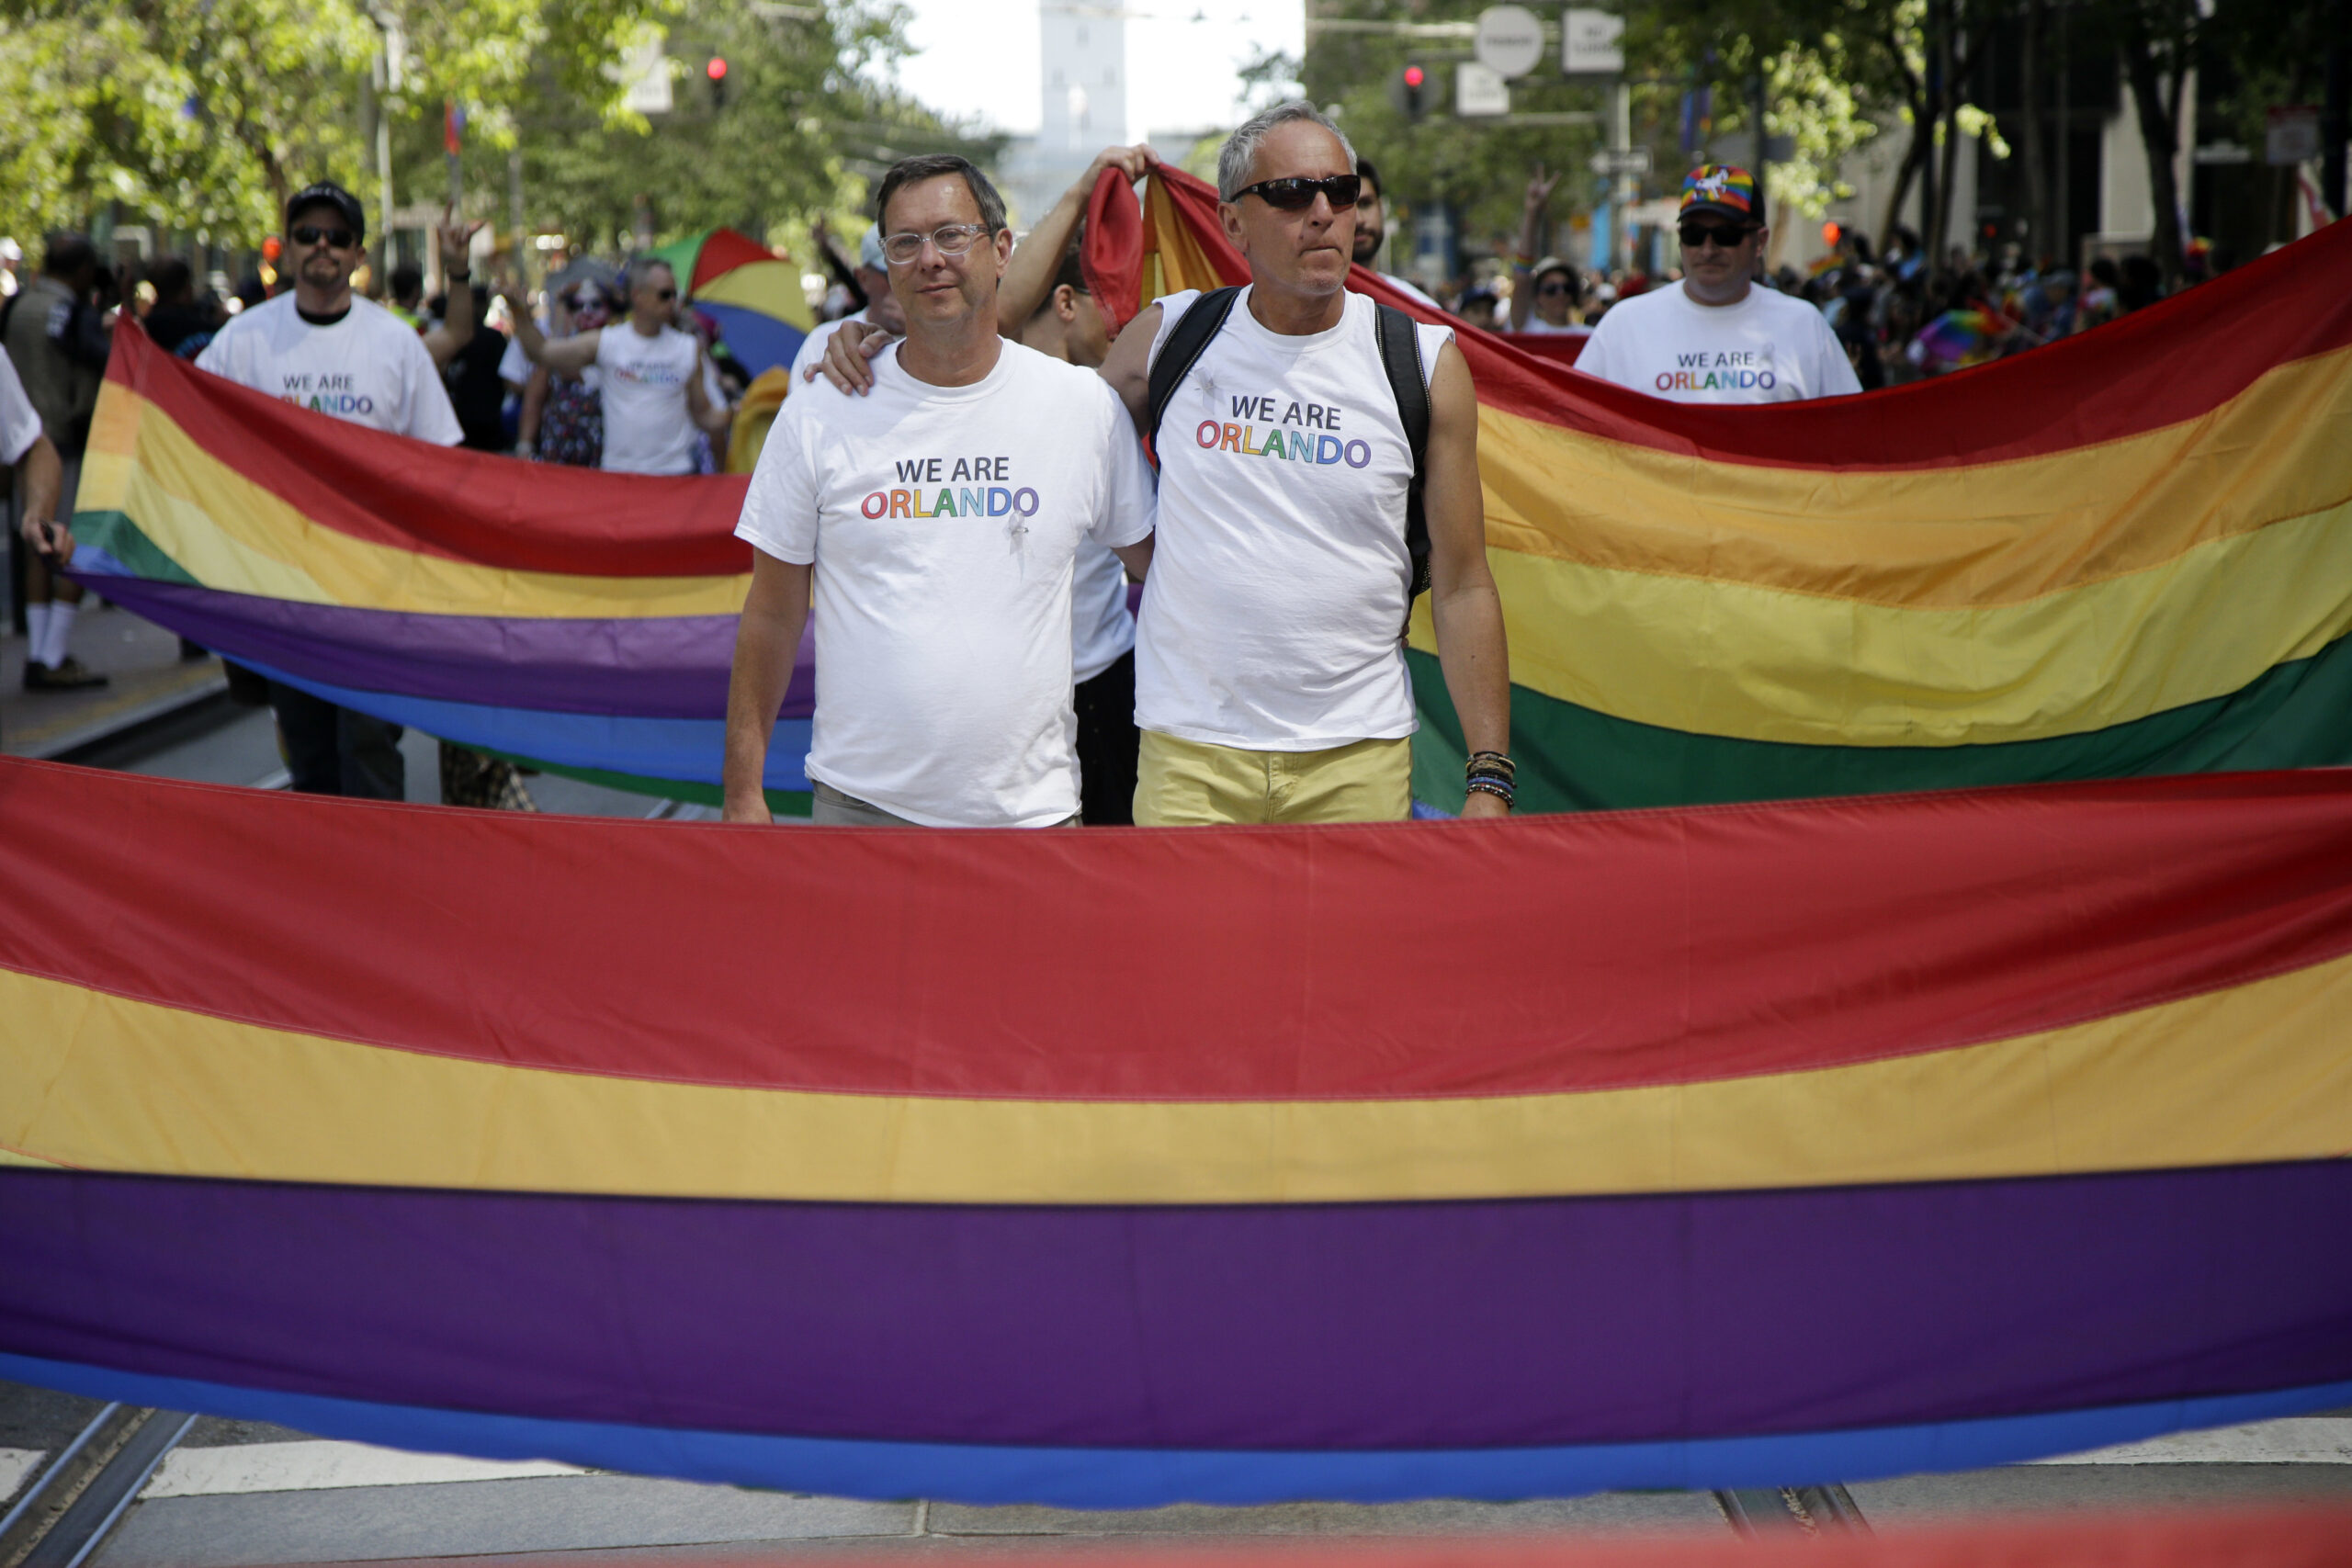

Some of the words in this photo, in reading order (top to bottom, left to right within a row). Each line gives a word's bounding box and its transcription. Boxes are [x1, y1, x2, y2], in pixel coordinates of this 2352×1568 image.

[1678, 351, 1708, 368] WE
[1715, 351, 1753, 367] ARE
[283, 373, 311, 390] WE
[318, 372, 353, 390] ARE
[1656, 369, 1776, 391] ORLANDO
[1232, 395, 1275, 422] WE
[1283, 401, 1341, 430] ARE
[1196, 420, 1372, 469] ORLANDO
[896, 458, 943, 483] WE
[951, 457, 1010, 482] ARE
[861, 487, 1040, 520] ORLANDO
